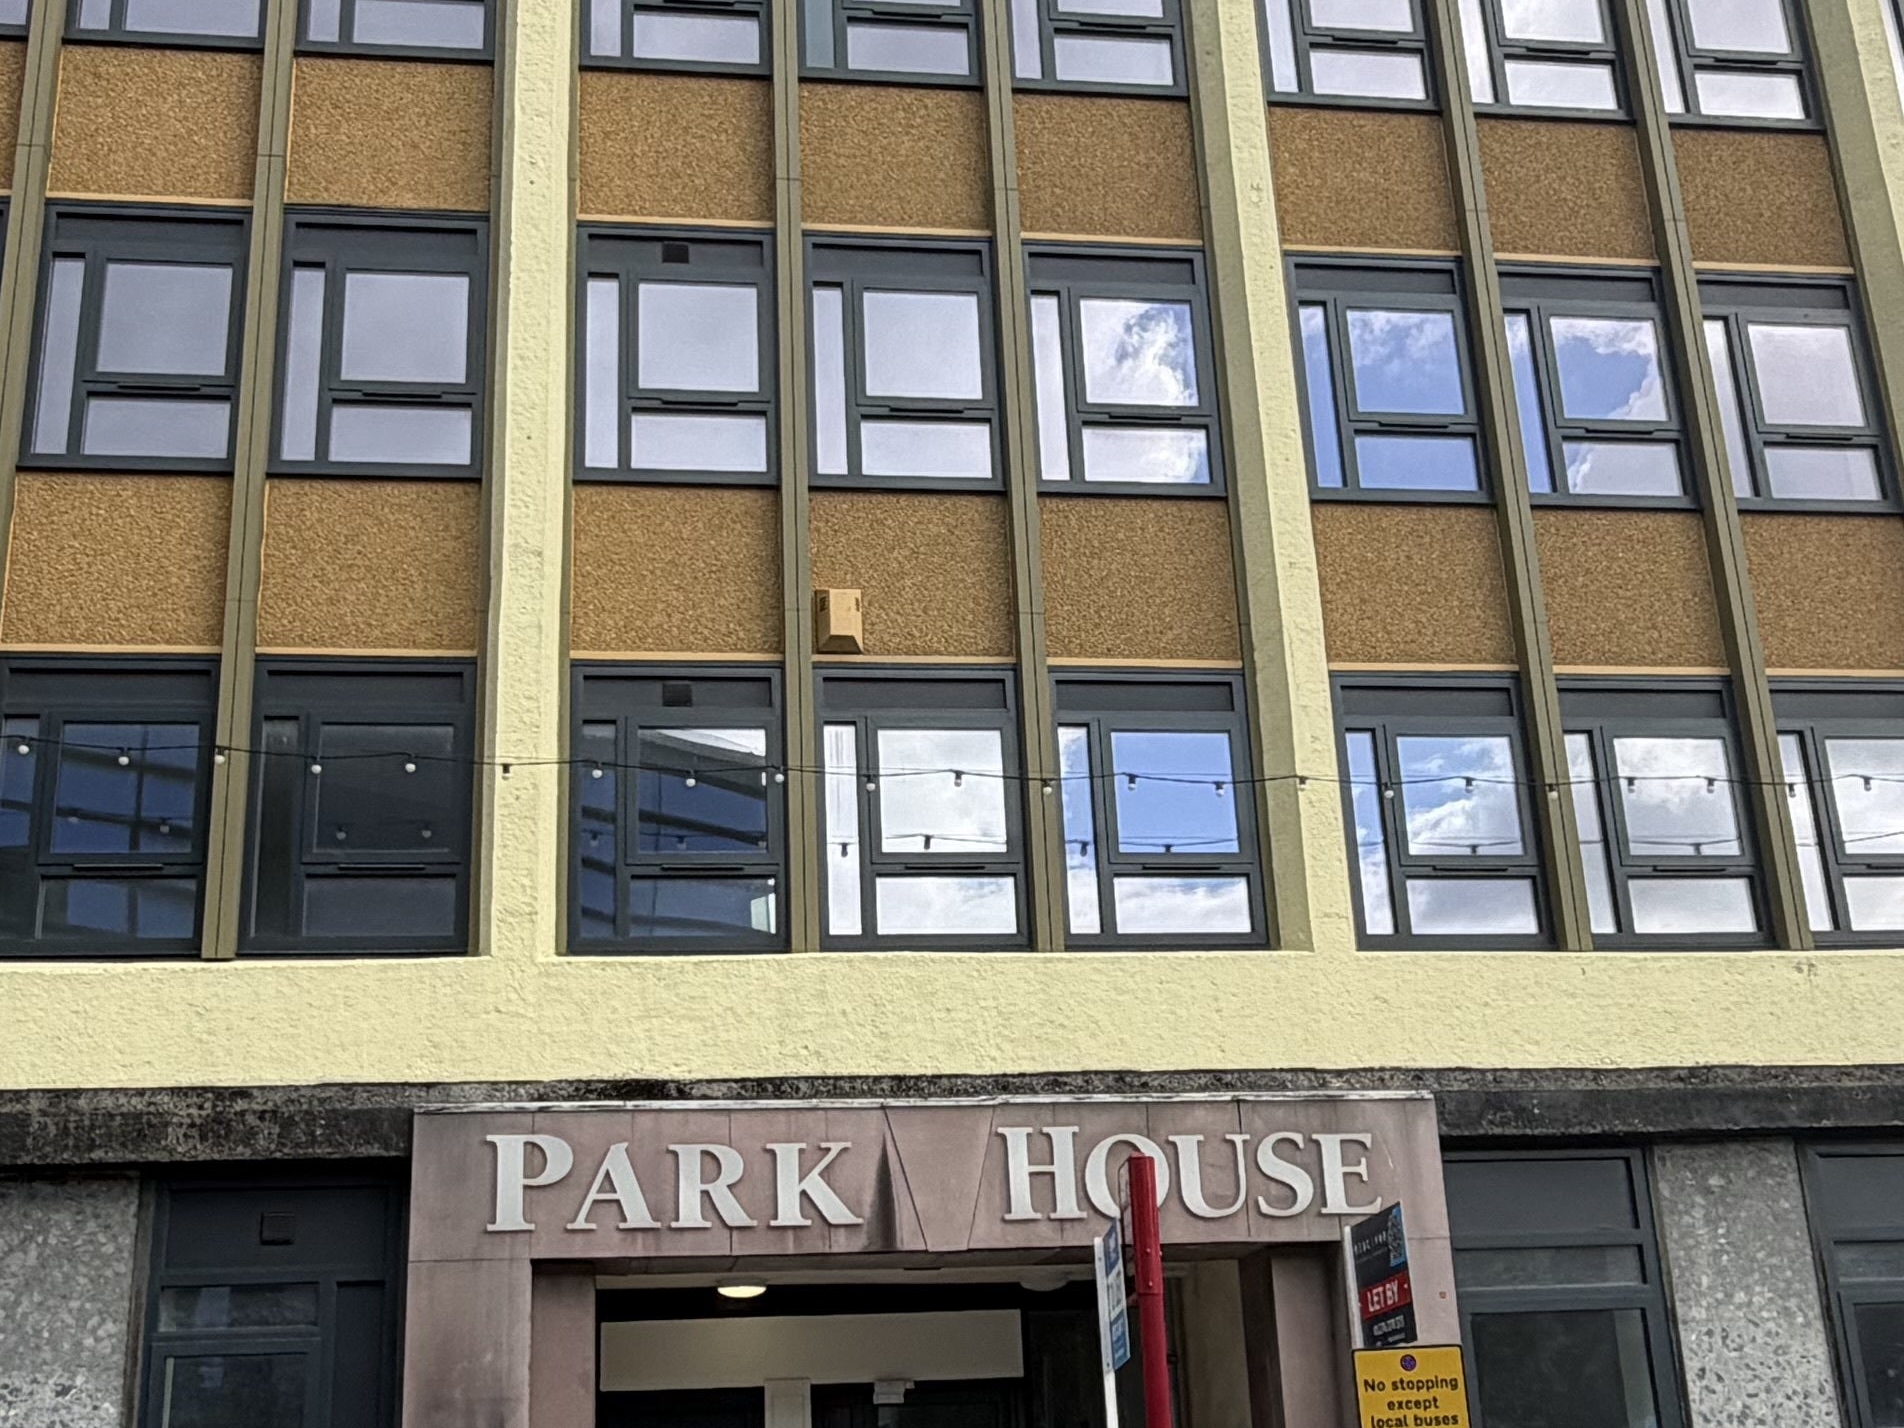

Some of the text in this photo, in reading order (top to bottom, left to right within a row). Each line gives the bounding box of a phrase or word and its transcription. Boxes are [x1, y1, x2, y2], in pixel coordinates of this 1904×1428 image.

[485, 1125, 1383, 1232] PARK HOUSE
[1367, 1280, 1399, 1312] LET BY
[1363, 1375, 1459, 1393] No stopping
[1387, 1396, 1440, 1411] except
[1370, 1414, 1459, 1428] local buses
